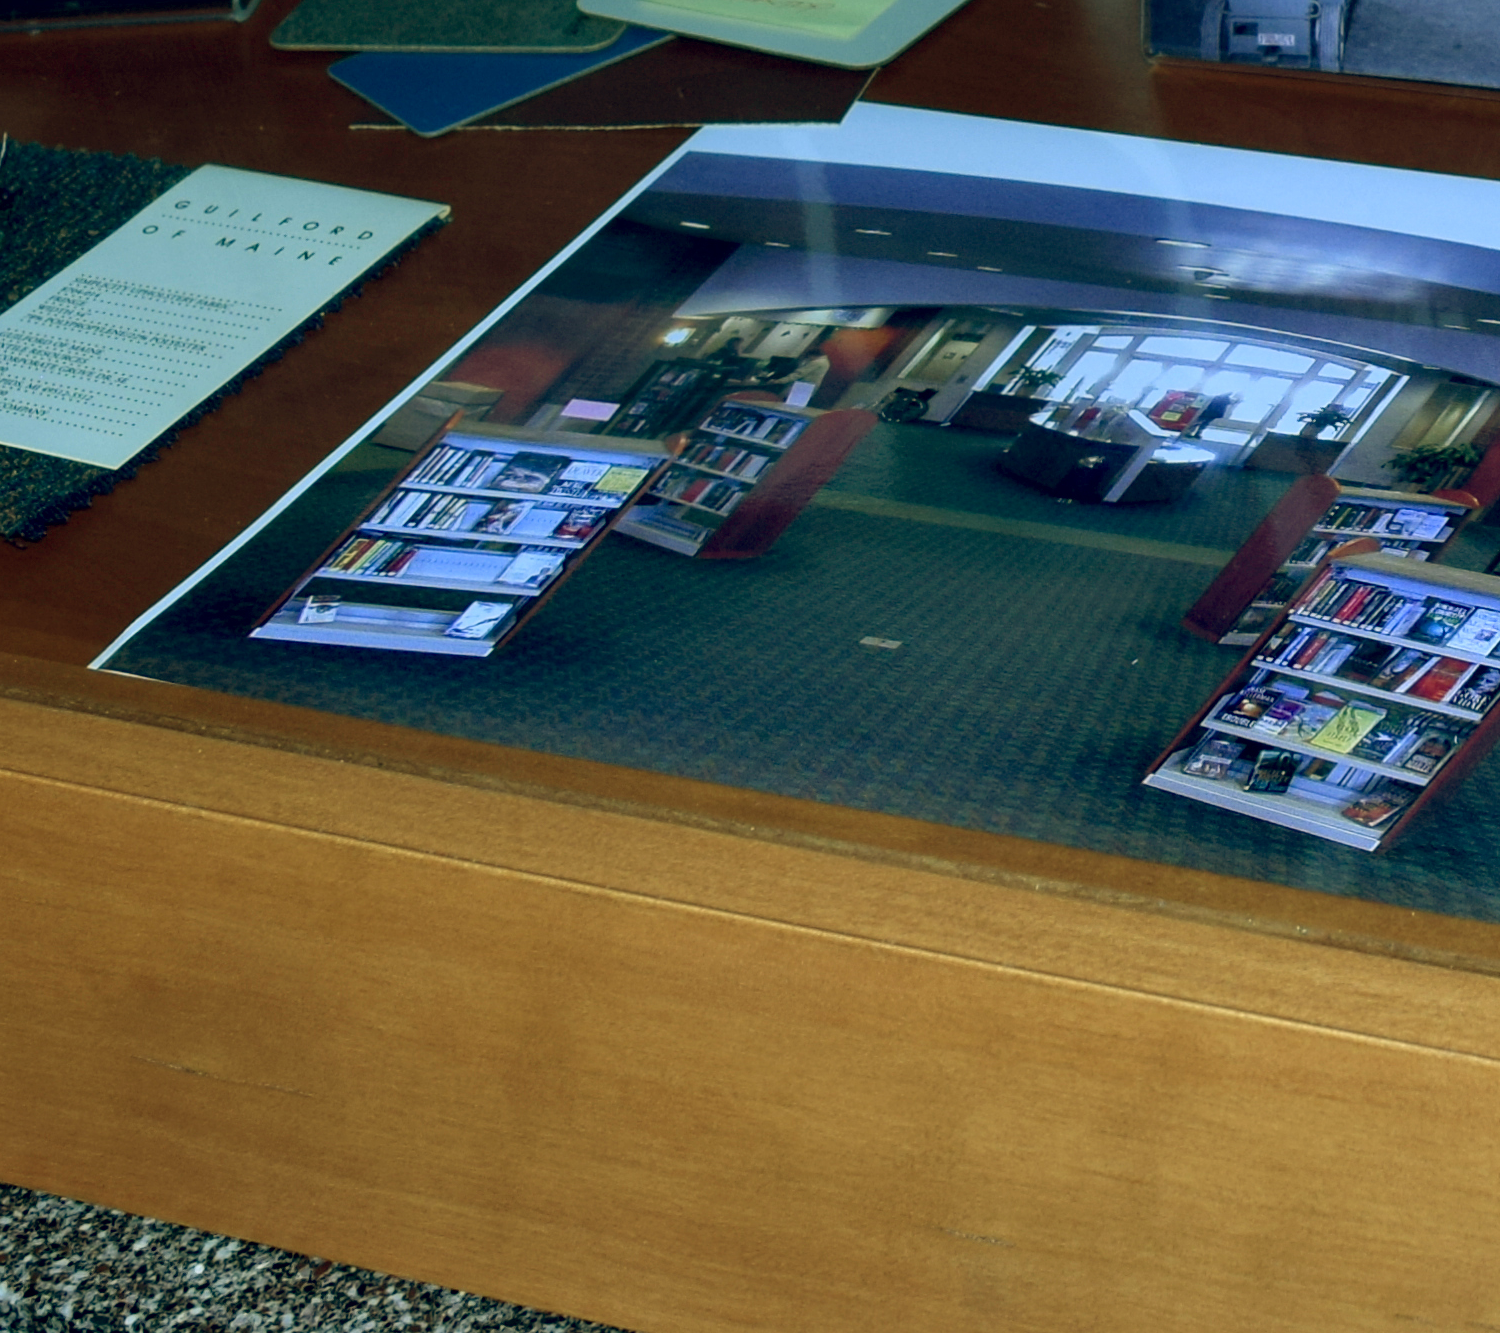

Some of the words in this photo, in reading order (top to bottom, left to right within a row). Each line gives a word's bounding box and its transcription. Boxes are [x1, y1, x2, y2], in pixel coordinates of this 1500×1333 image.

[174, 199, 374, 241] GUILFORD
[141, 224, 187, 240] OF
[214, 236, 344, 267] MAINE
